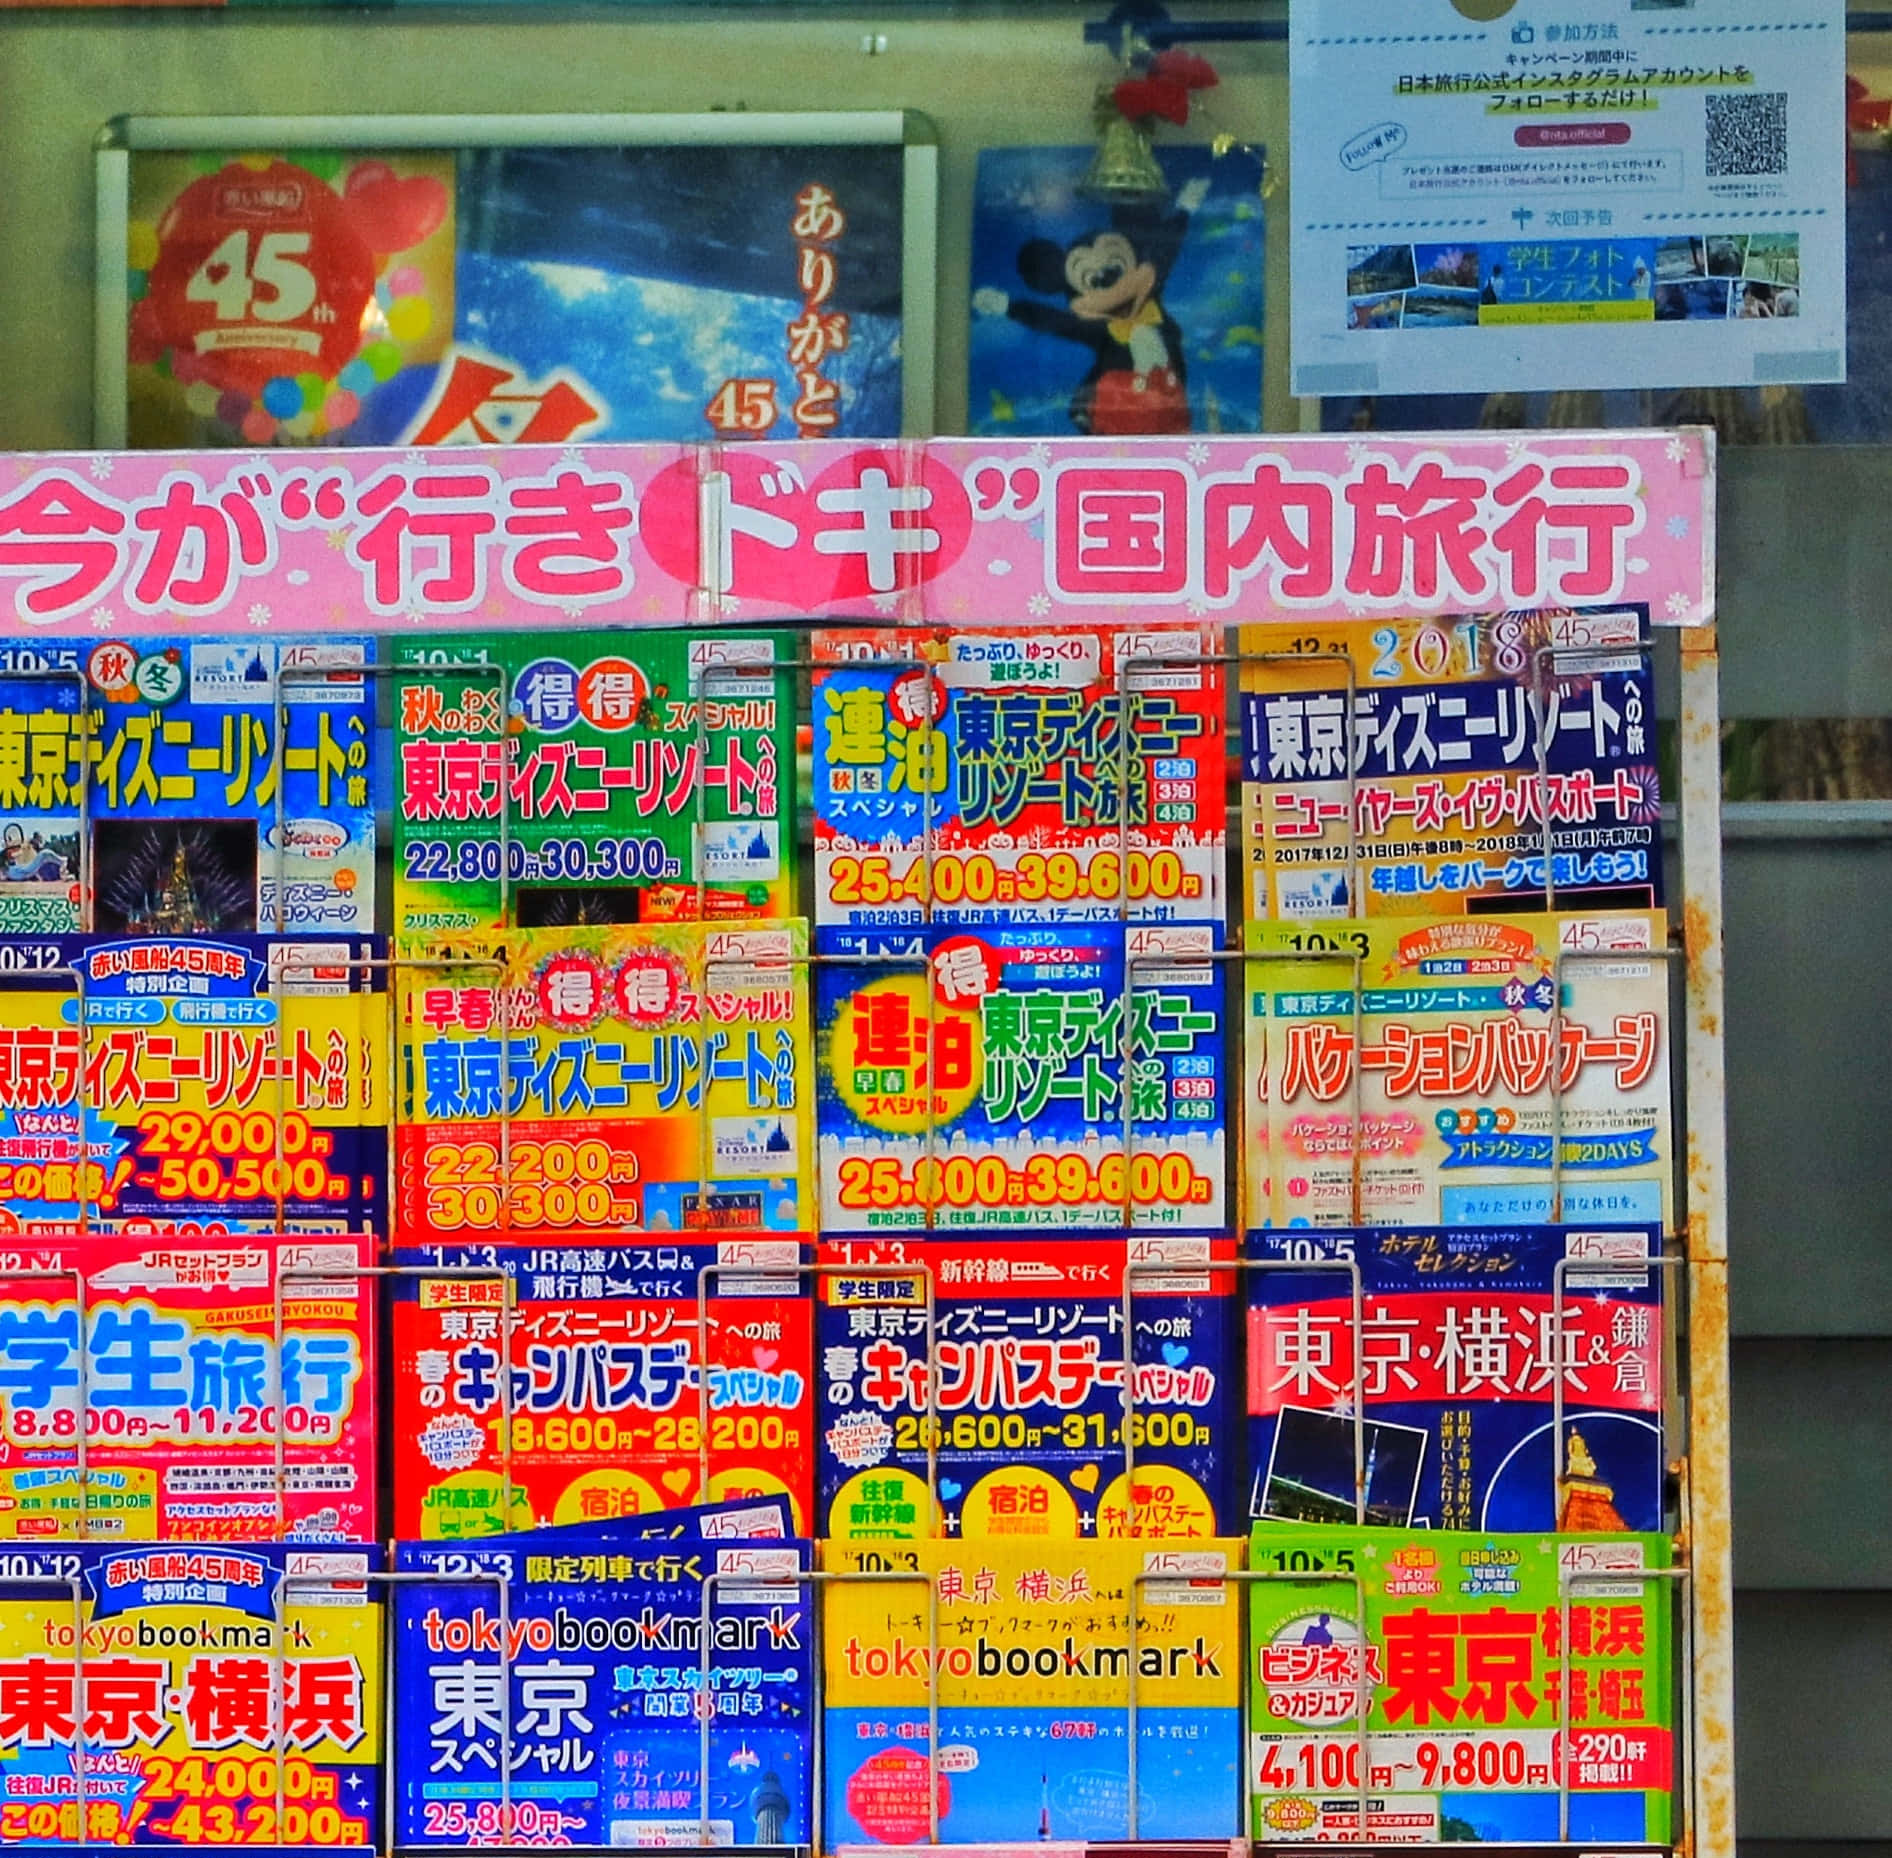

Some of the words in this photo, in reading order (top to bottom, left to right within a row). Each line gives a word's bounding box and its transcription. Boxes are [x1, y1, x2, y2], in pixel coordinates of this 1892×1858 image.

[1545, 23, 1618, 41] 参加方法
[1505, 50, 1638, 65] キャンペーン期間中に
[1398, 66, 1750, 93] 日本旅行公式インスタグラムアカウントを
[1545, 209, 1613, 226] 次回予告
[1519, 275, 1623, 298] コンテスト
[1371, 618, 1526, 677] 2018
[1265, 694, 1620, 779] 東京ディズニーリゾート
[402, 740, 755, 820] 東京ディズニーリゾート
[91, 950, 245, 977] 赤い風船45周年
[126, 977, 209, 996] 特別企画
[1283, 1015, 1655, 1098] バケーションパッケージ
[527, 1555, 702, 1582] 限定列車で行く
[423, 1609, 799, 1650] tokyobookmark
[844, 1635, 1223, 1681] tokyobookmark
